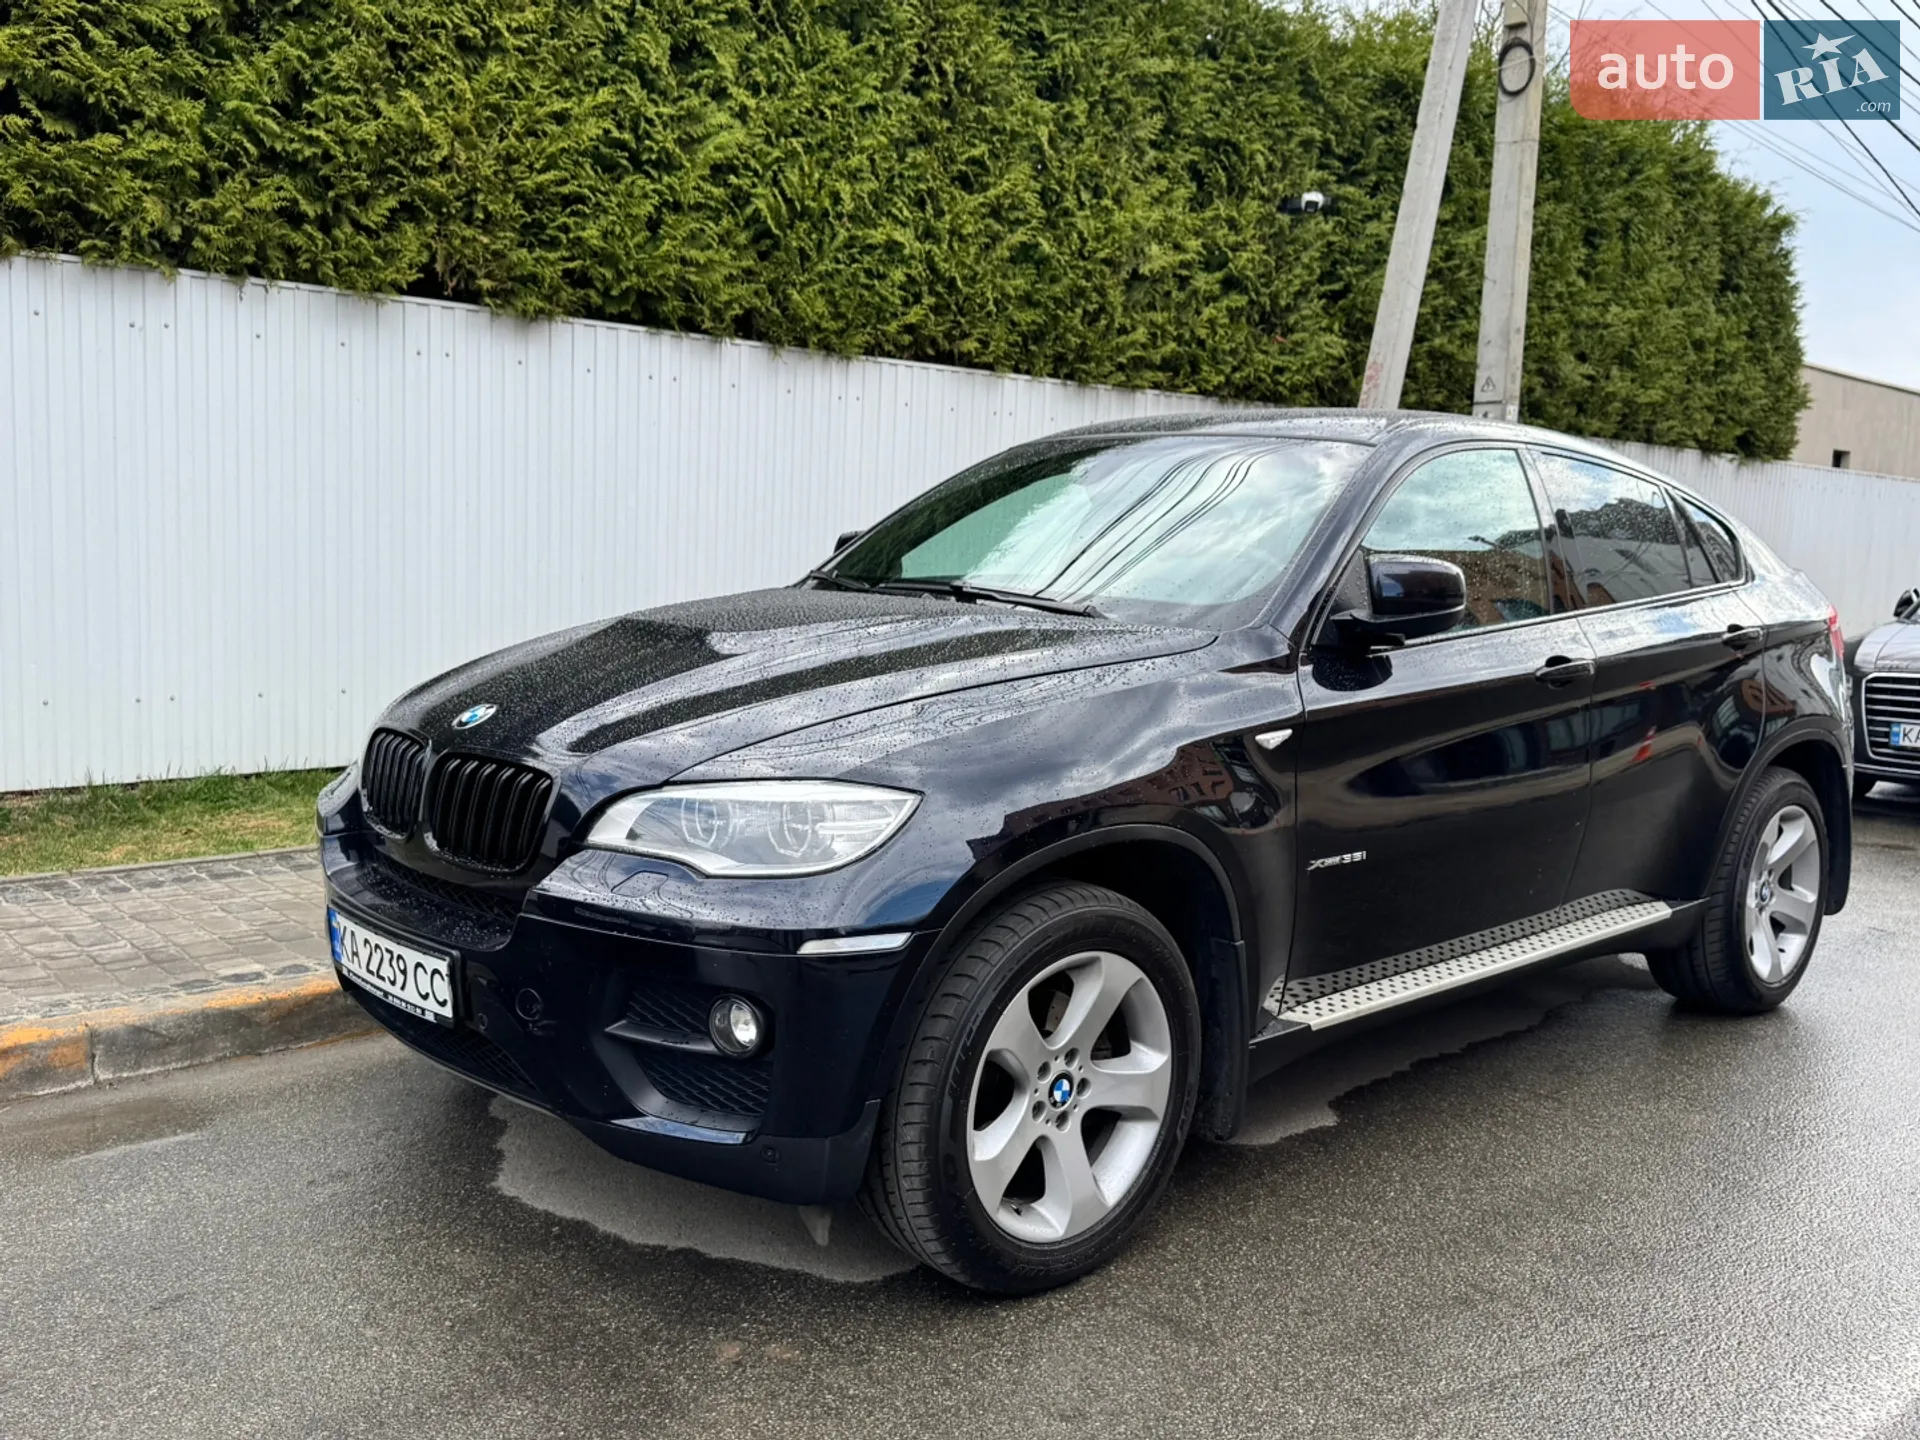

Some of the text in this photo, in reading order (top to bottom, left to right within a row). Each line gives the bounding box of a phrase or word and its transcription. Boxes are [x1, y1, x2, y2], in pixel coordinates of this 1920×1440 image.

[339, 921, 362, 969] KA
[363, 937, 408, 991] 2239
[413, 961, 448, 1008] CC
